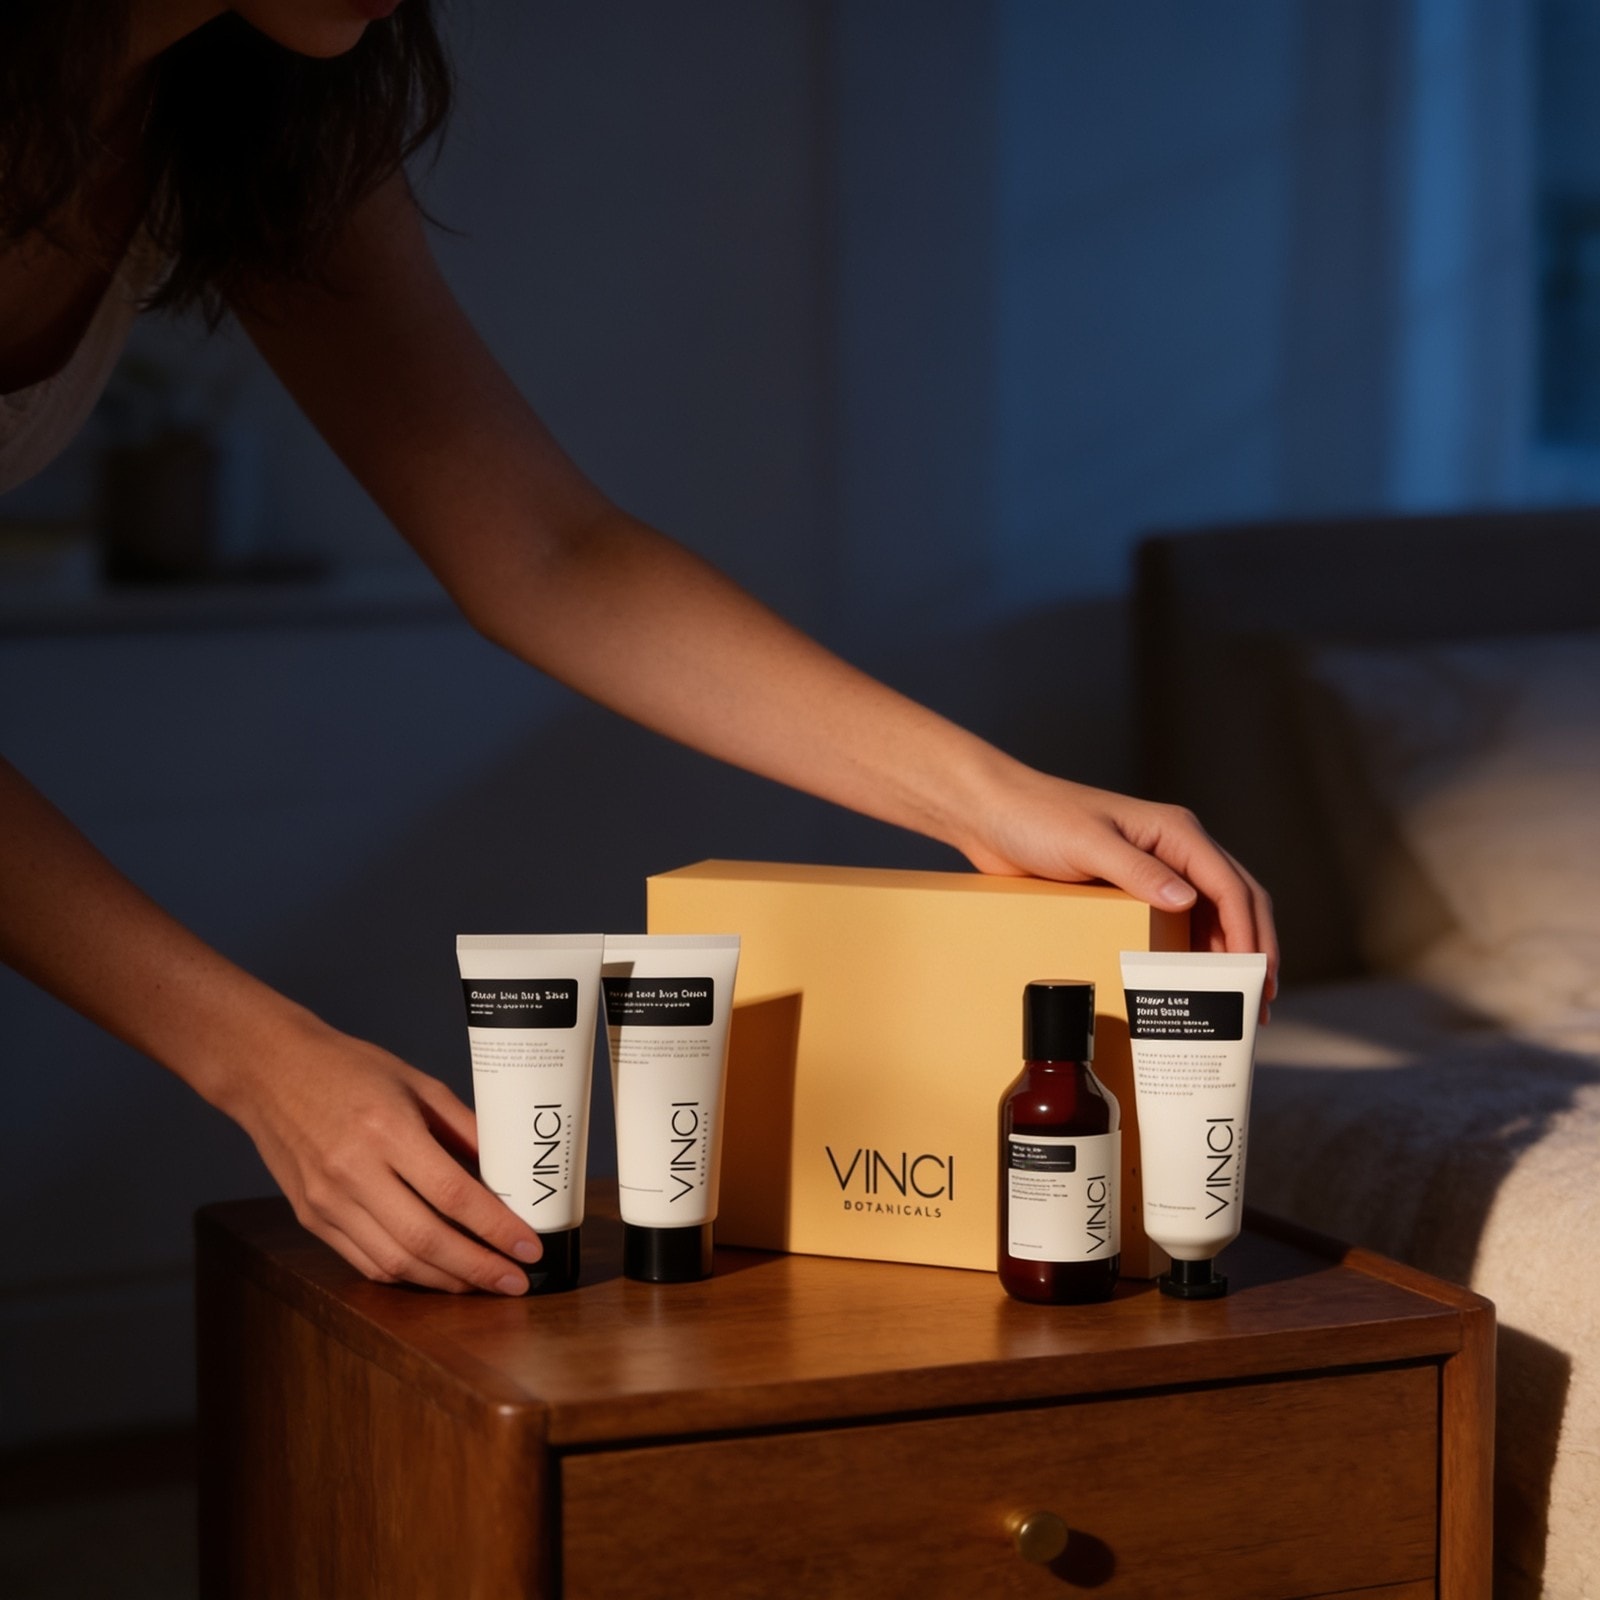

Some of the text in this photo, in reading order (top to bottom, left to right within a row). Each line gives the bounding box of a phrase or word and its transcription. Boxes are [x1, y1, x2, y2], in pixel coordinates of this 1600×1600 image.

[532, 1104, 562, 1206] VINCI
[669, 1102, 699, 1203] VINCI
[825, 1146, 953, 1201] VINCI
[1205, 1118, 1234, 1220] VINCI
[844, 1200, 942, 1218] BOTANICALS
[1086, 1175, 1106, 1254] VINCI
